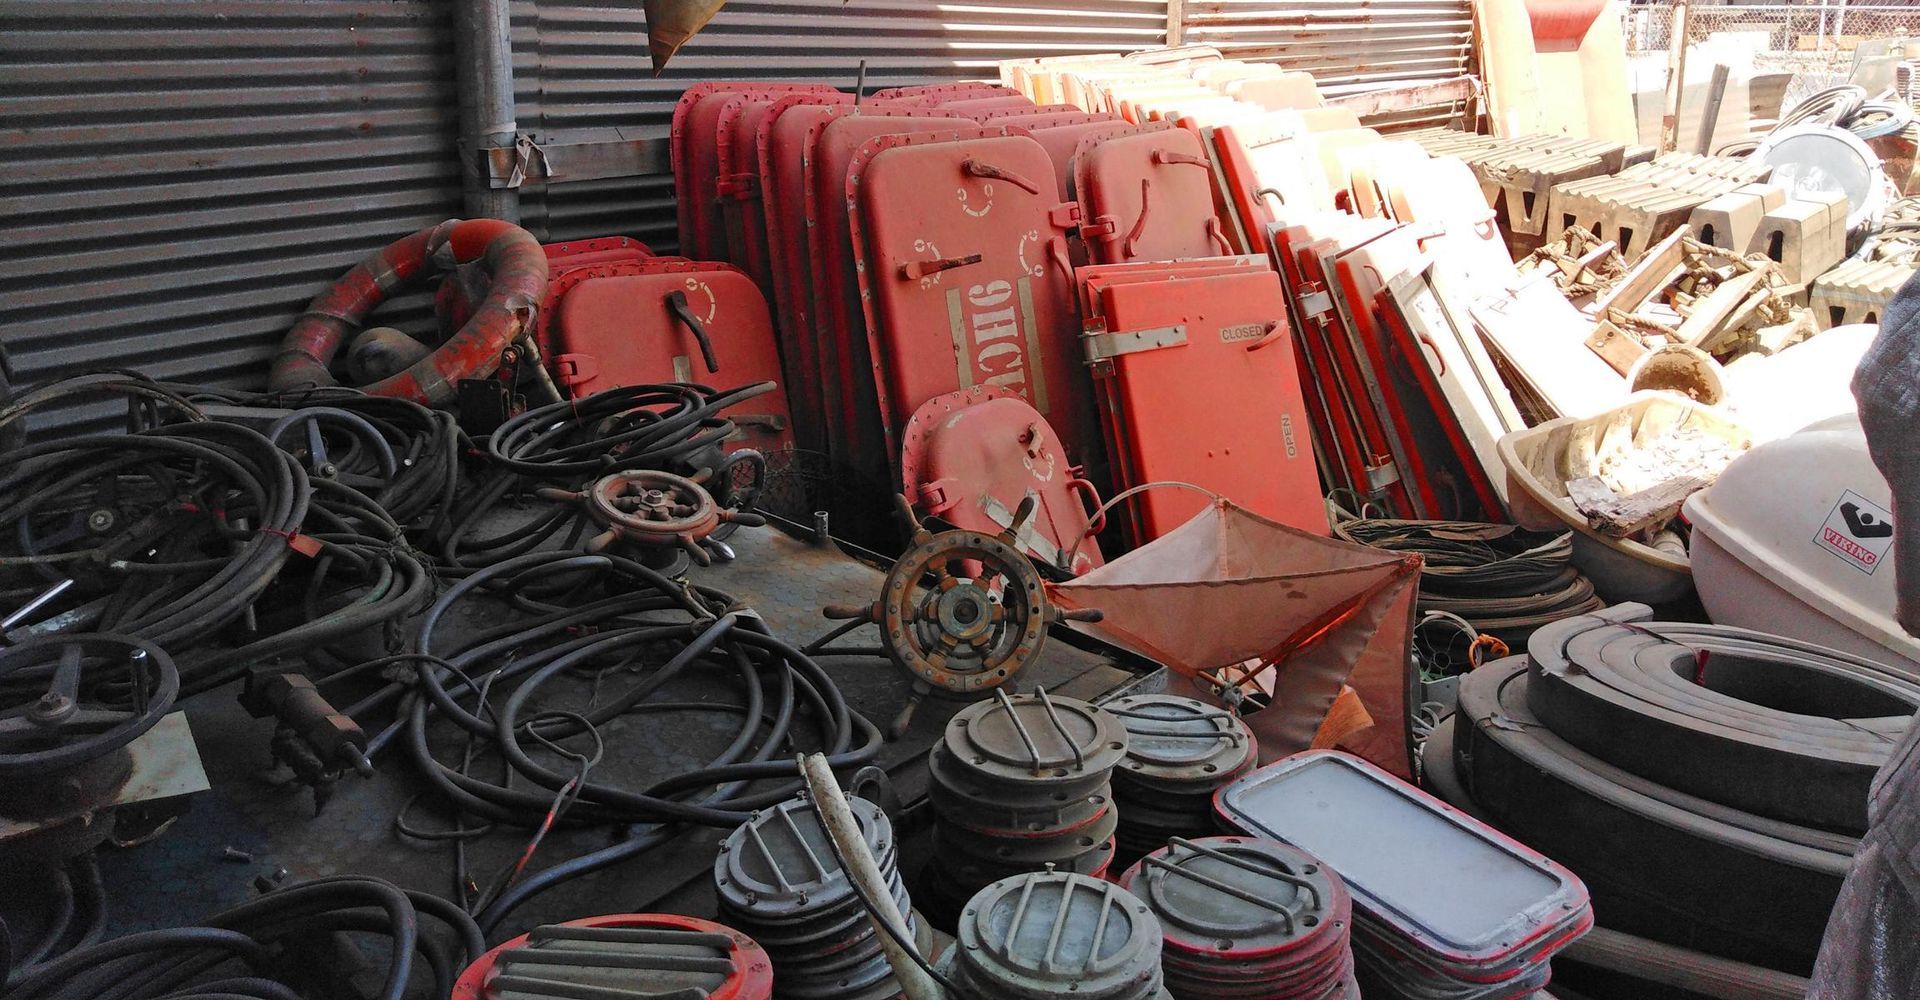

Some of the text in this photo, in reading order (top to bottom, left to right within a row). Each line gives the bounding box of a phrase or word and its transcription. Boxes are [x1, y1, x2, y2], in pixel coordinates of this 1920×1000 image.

[1222, 326, 1262, 340] CLOSED
[1282, 417, 1296, 457] OPEN
[1824, 527, 1877, 565] VIKING
